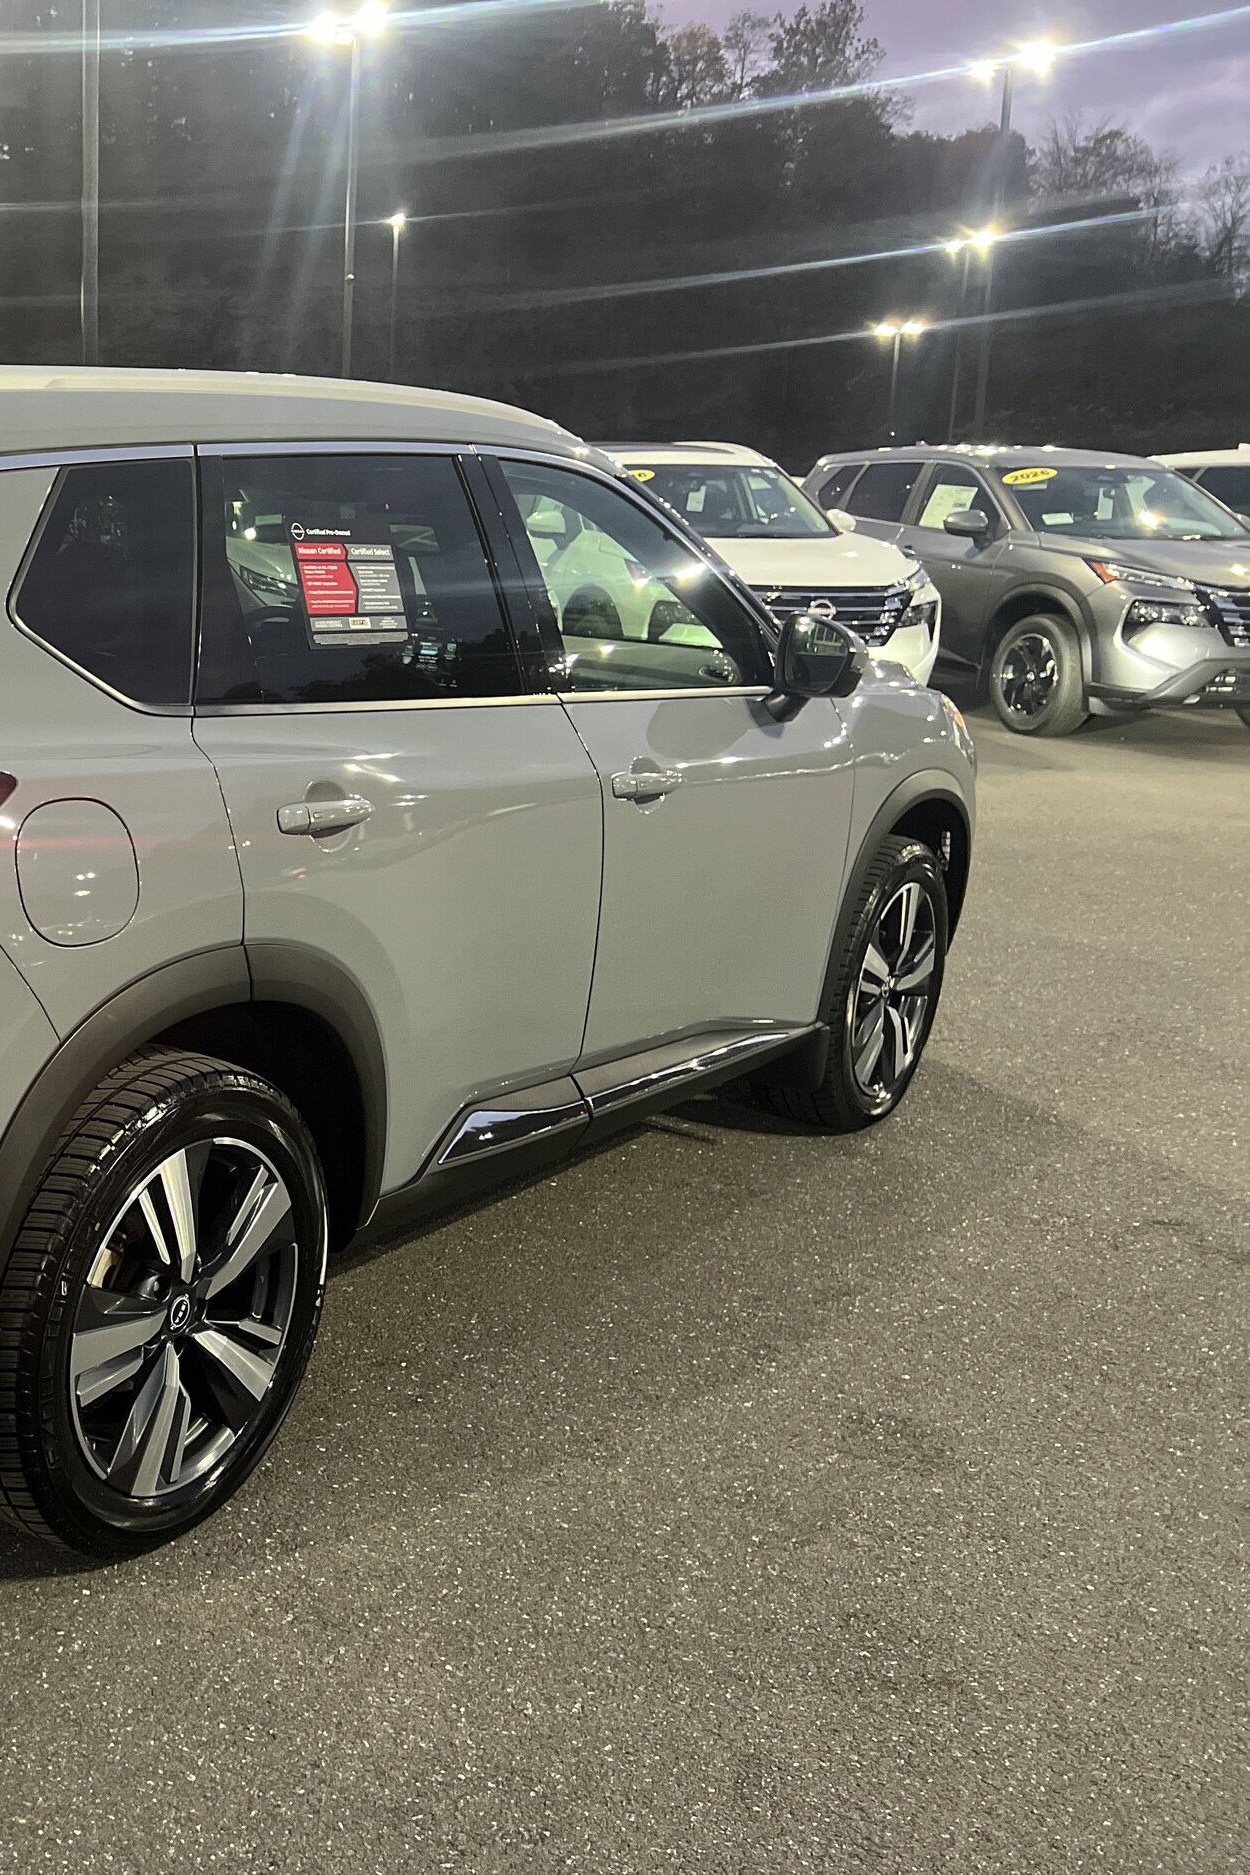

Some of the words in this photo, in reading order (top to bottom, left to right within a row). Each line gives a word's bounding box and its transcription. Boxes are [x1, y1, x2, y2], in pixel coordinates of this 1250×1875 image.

[306, 528, 326, 536] Certified
[298, 547, 317, 555] Nissan
[317, 547, 342, 555] Certified
[350, 547, 373, 555] Certified
[373, 548, 391, 556] Select
